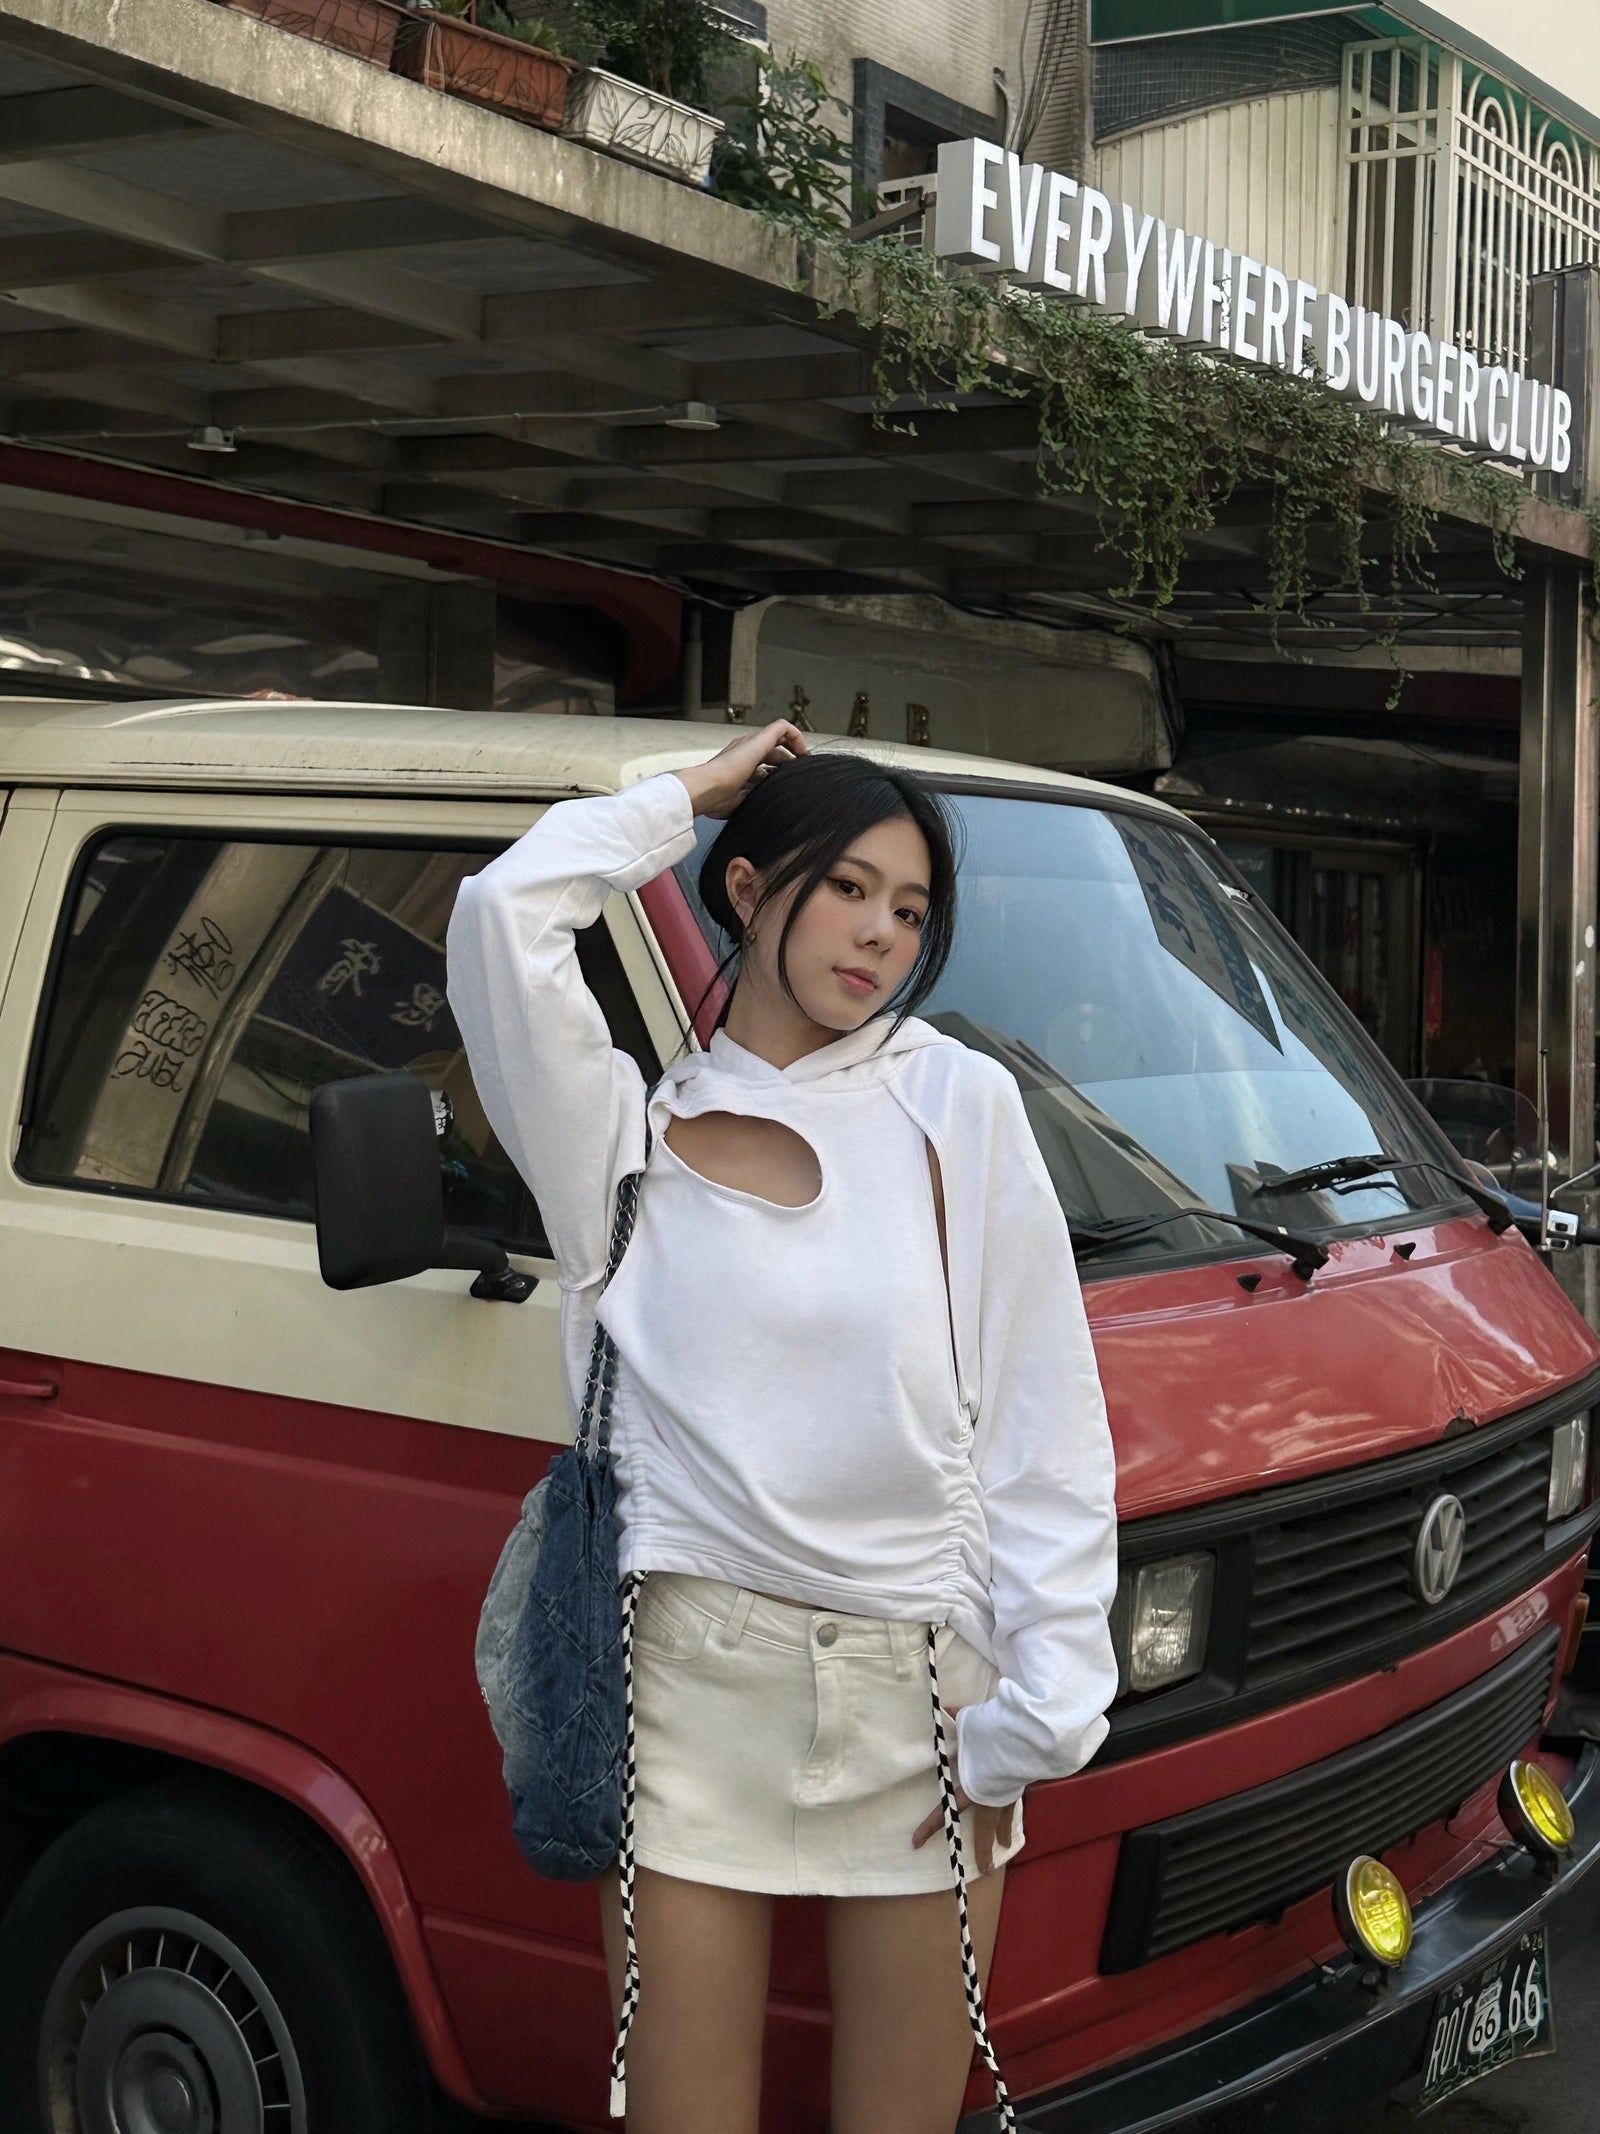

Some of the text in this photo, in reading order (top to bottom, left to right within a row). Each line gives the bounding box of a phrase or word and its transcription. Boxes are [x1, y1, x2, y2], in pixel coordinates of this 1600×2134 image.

[971, 136, 1572, 474] EVERYWHERE BURGER CLUB
[1508, 1957, 1541, 2033] 66
